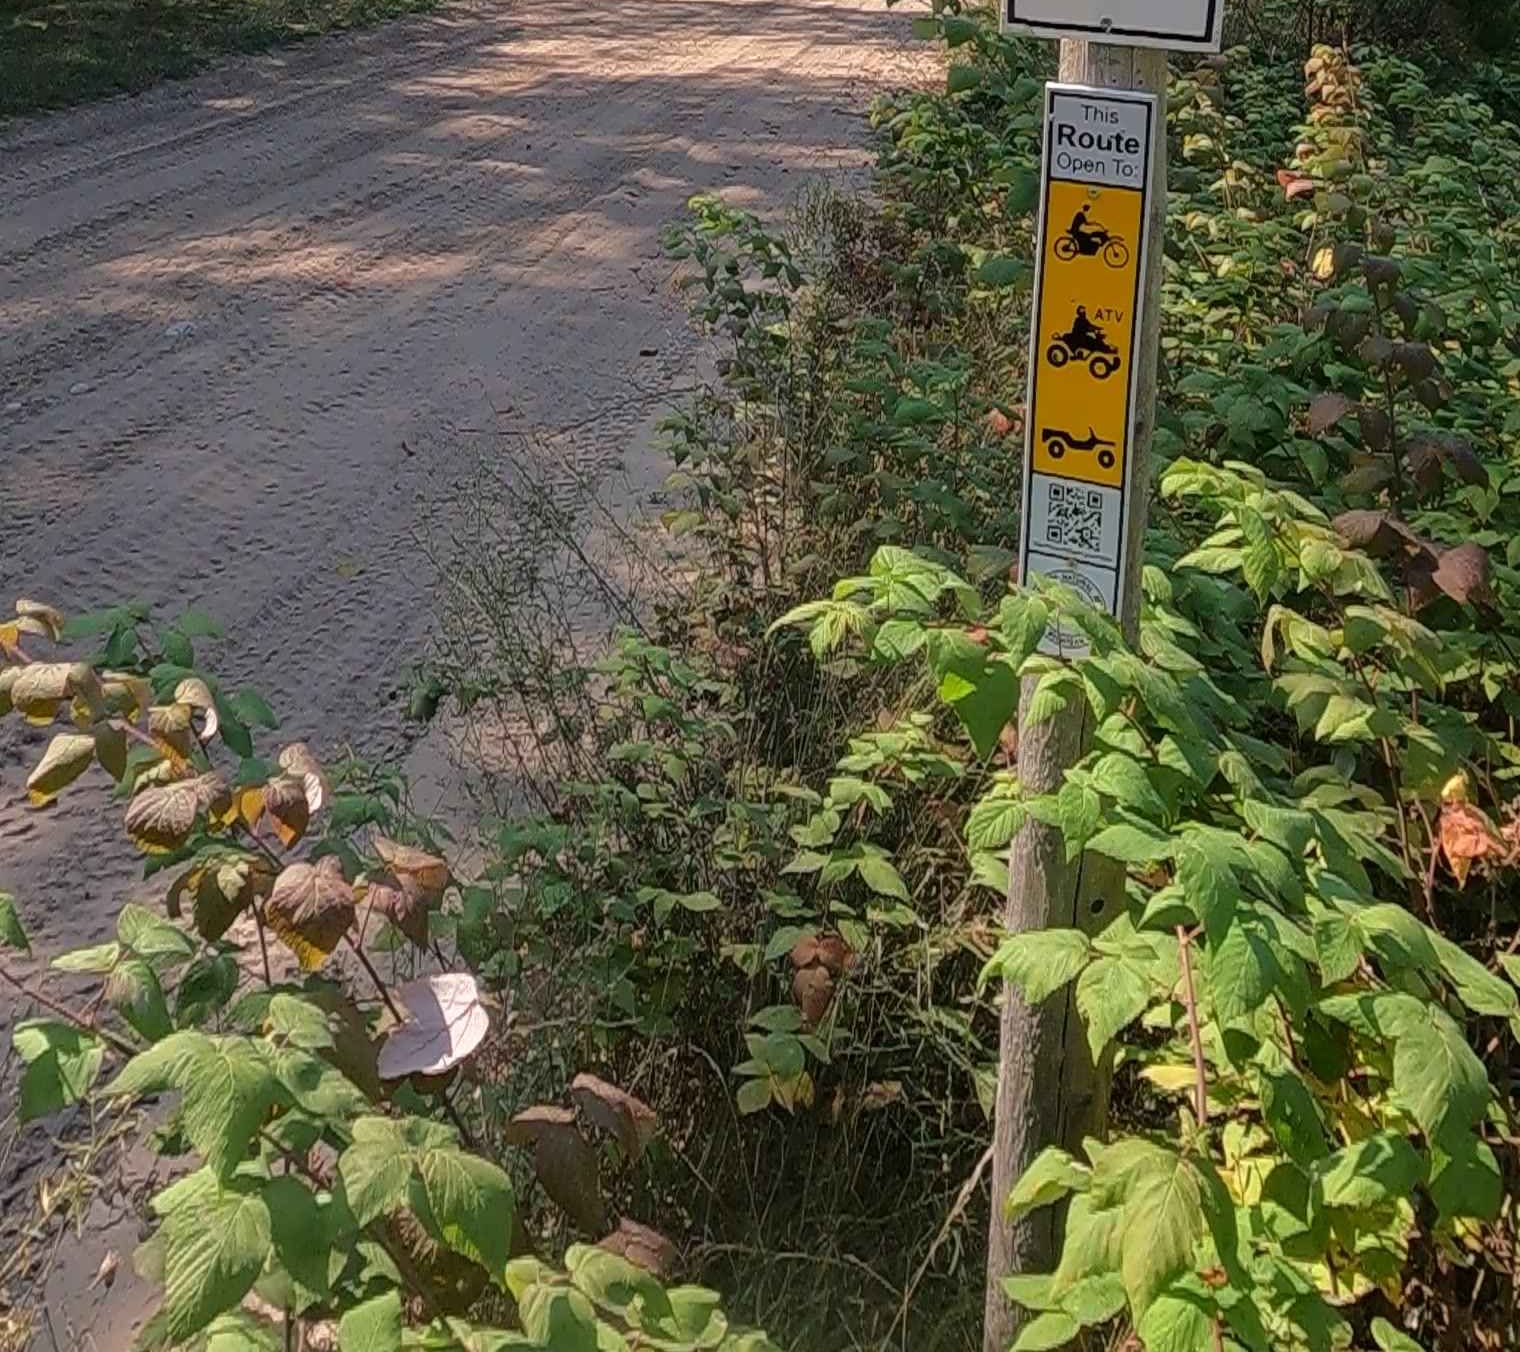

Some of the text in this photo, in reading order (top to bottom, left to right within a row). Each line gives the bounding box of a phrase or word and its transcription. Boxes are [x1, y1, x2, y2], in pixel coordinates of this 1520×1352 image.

[1081, 104, 1119, 124] This
[1058, 123, 1140, 154] Route
[1057, 151, 1105, 176] Open
[1094, 308, 1123, 323] ATV
